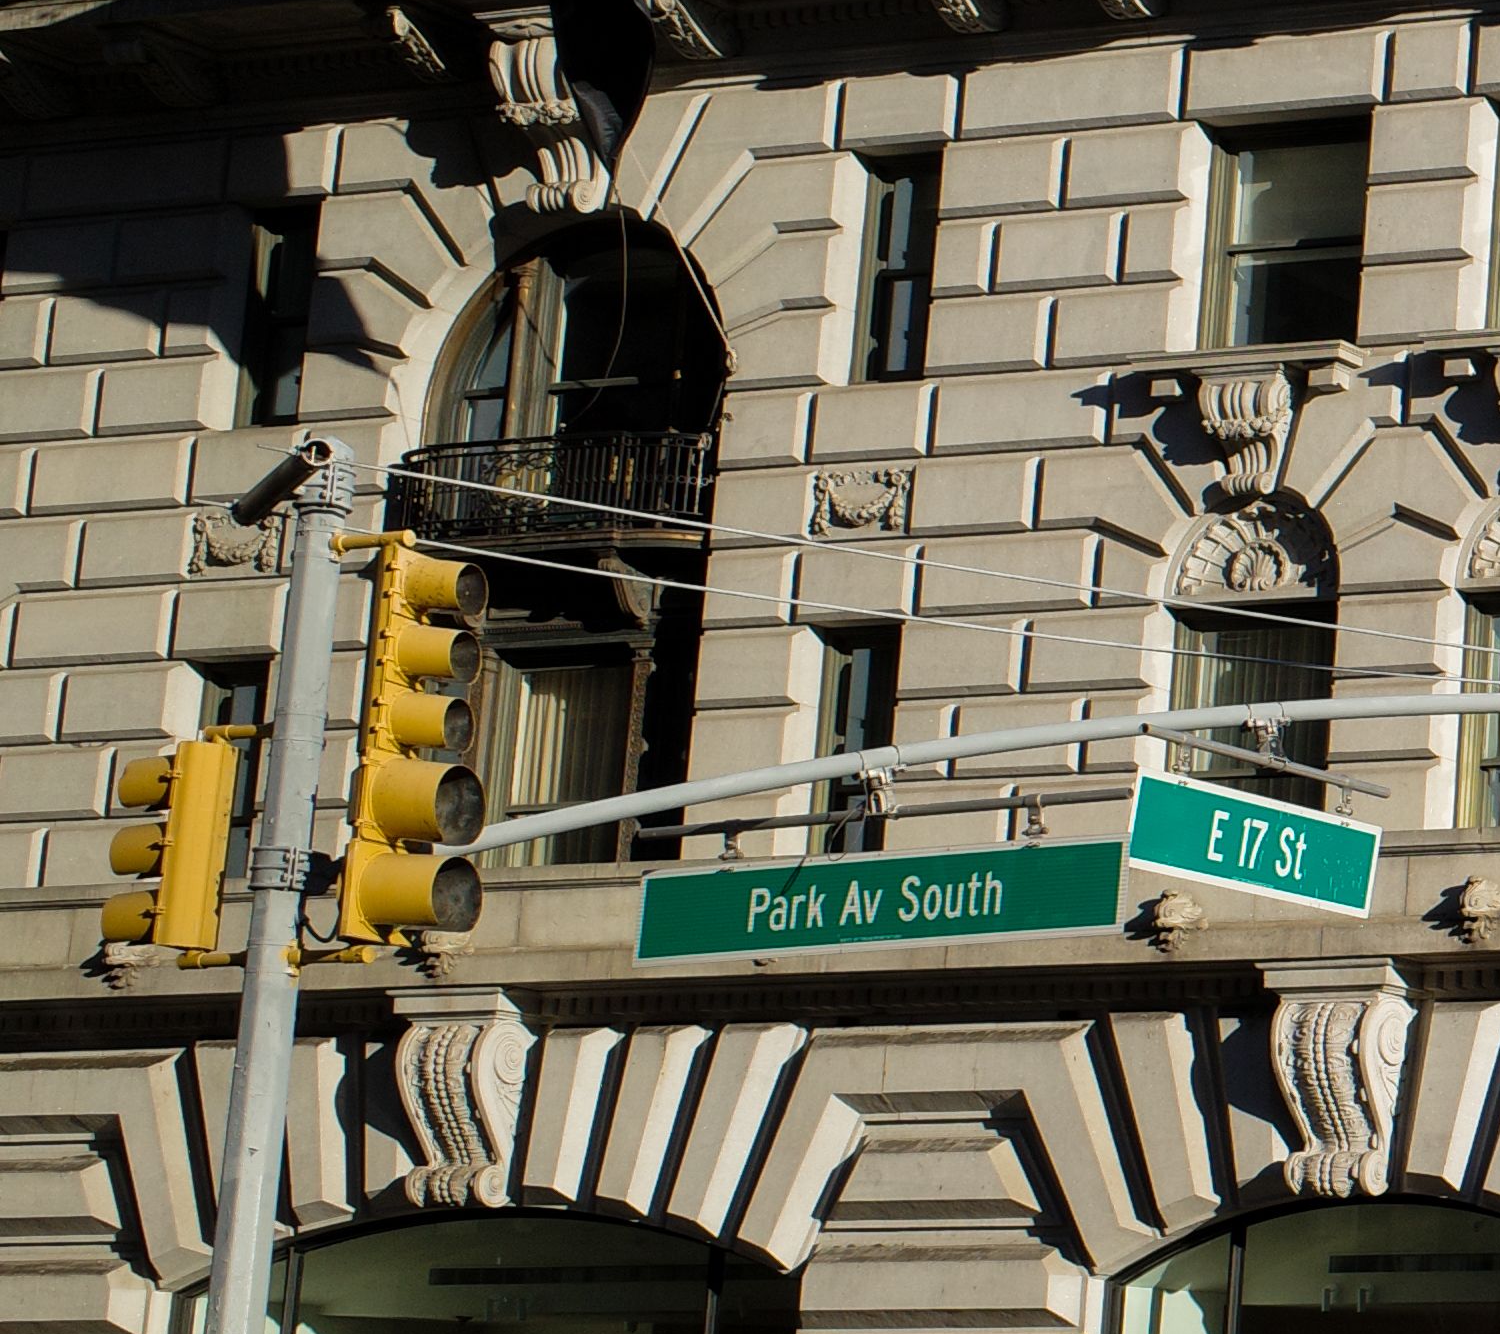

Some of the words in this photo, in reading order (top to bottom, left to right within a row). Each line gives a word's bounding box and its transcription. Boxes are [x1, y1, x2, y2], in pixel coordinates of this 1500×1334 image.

[1206, 809, 1231, 863] E
[1237, 818, 1270, 871] 17
[1274, 825, 1308, 881] St
[746, 884, 826, 934] Park
[839, 879, 884, 926] Av
[897, 870, 1004, 922] South
